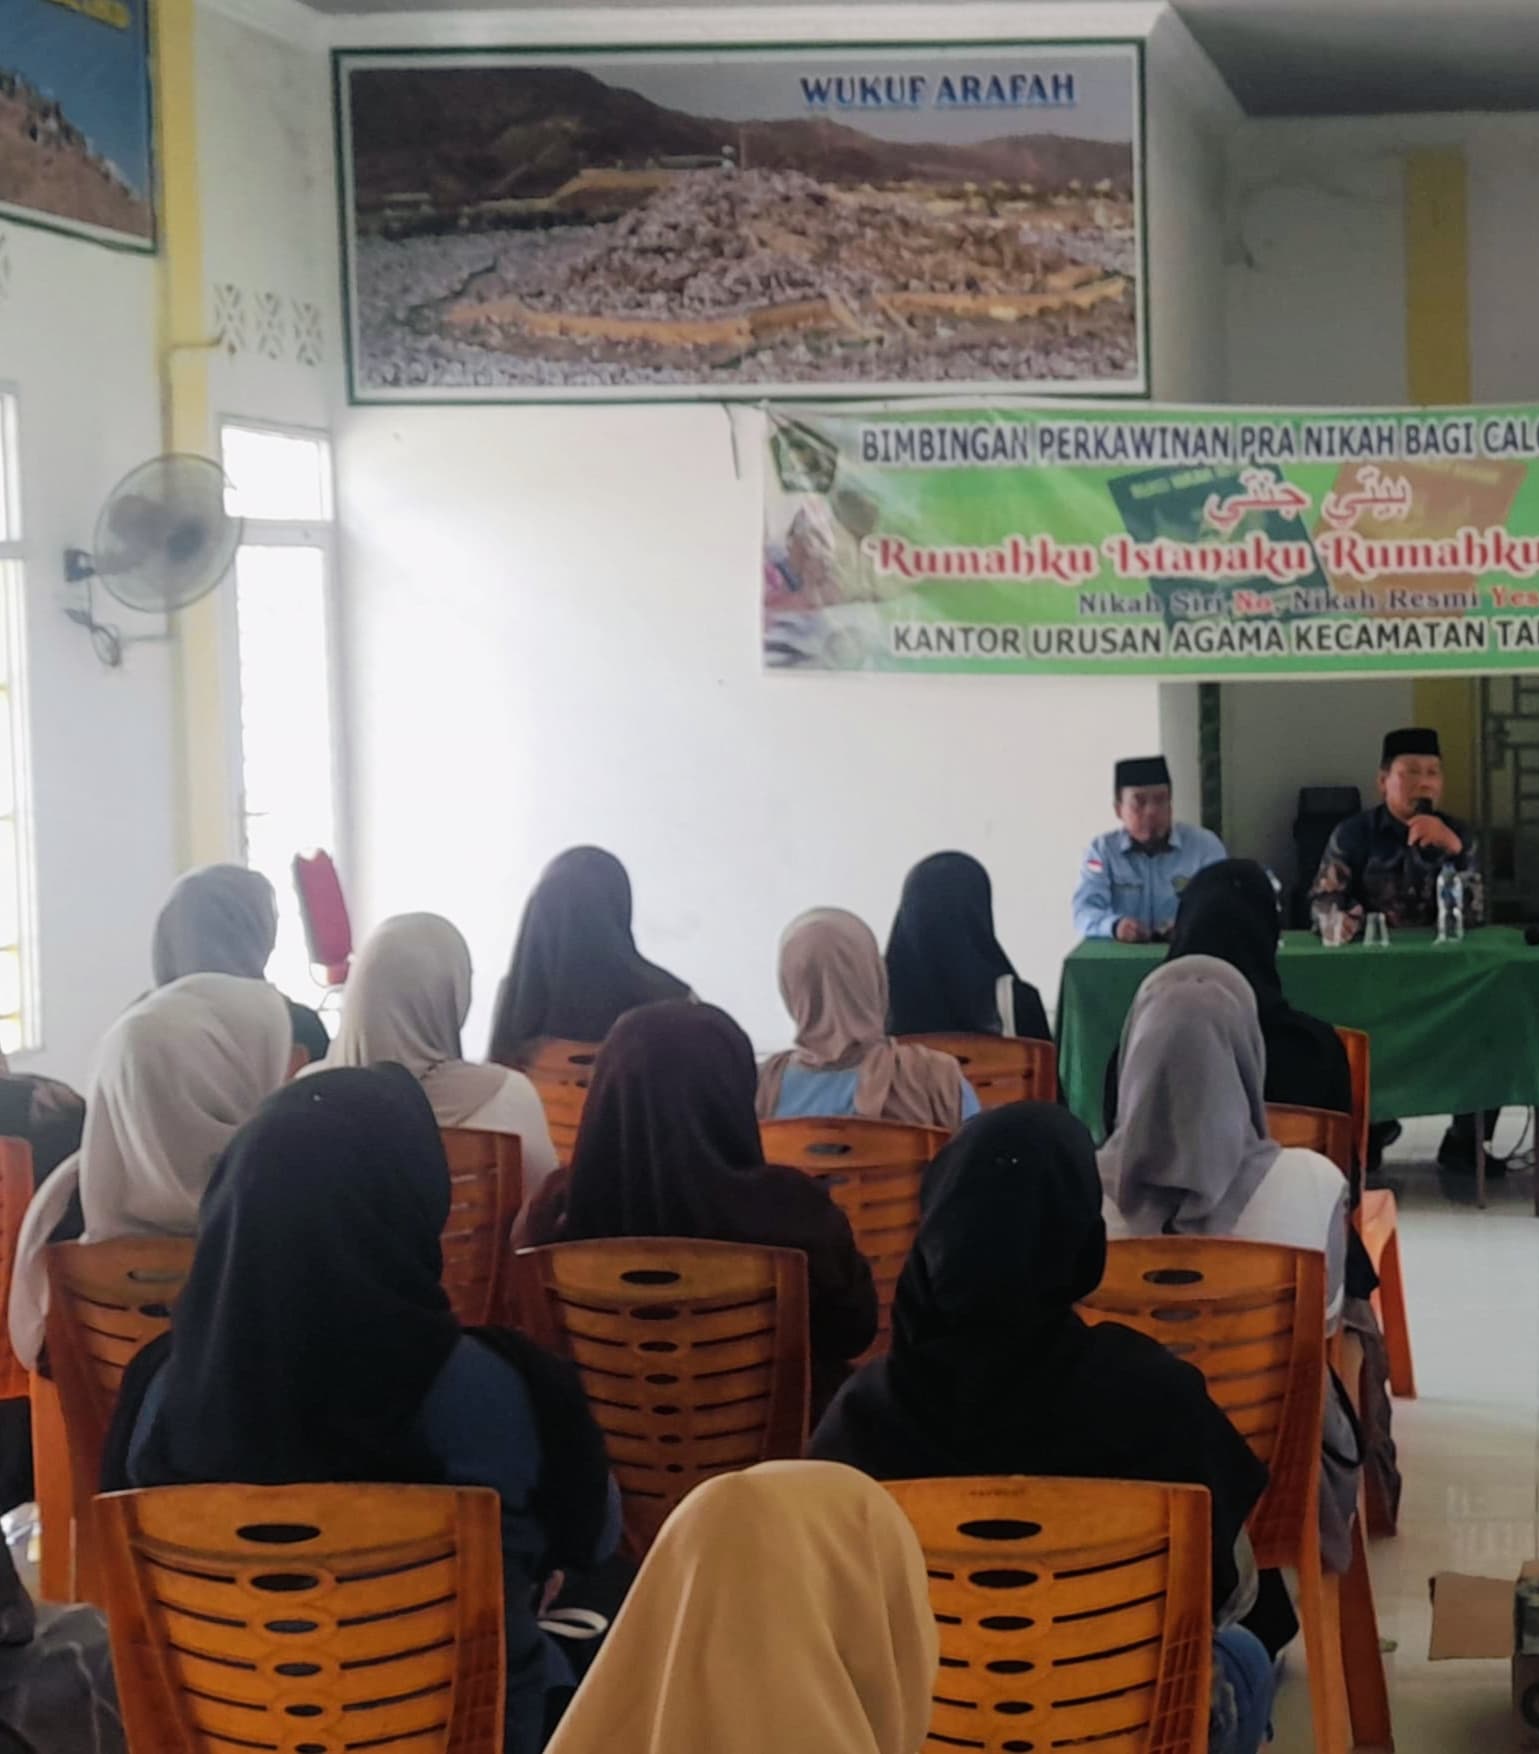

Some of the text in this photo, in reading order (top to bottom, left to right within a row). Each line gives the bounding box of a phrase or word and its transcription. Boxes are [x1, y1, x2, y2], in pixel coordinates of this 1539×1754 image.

[800, 73, 1075, 106] WUKUF ARAFAH
[862, 426, 1029, 462] BIMBINGAN
[1038, 424, 1229, 461] PERKAWINAN
[1241, 426, 1294, 457] PRA
[1304, 424, 1393, 457] NIKAH
[1404, 422, 1473, 455] BAGI
[867, 537, 1093, 582] Rumahku
[1106, 536, 1307, 578] Istanaku
[1079, 592, 1163, 614] Nikah
[1172, 590, 1225, 613] Siri
[1293, 588, 1376, 611] Nikah
[1389, 586, 1479, 609] Resmi
[894, 626, 1021, 653] KANTOR
[1033, 626, 1163, 655] URUSAN
[1172, 625, 1285, 652] AGAMA
[1295, 621, 1485, 650] KECAMATAN
